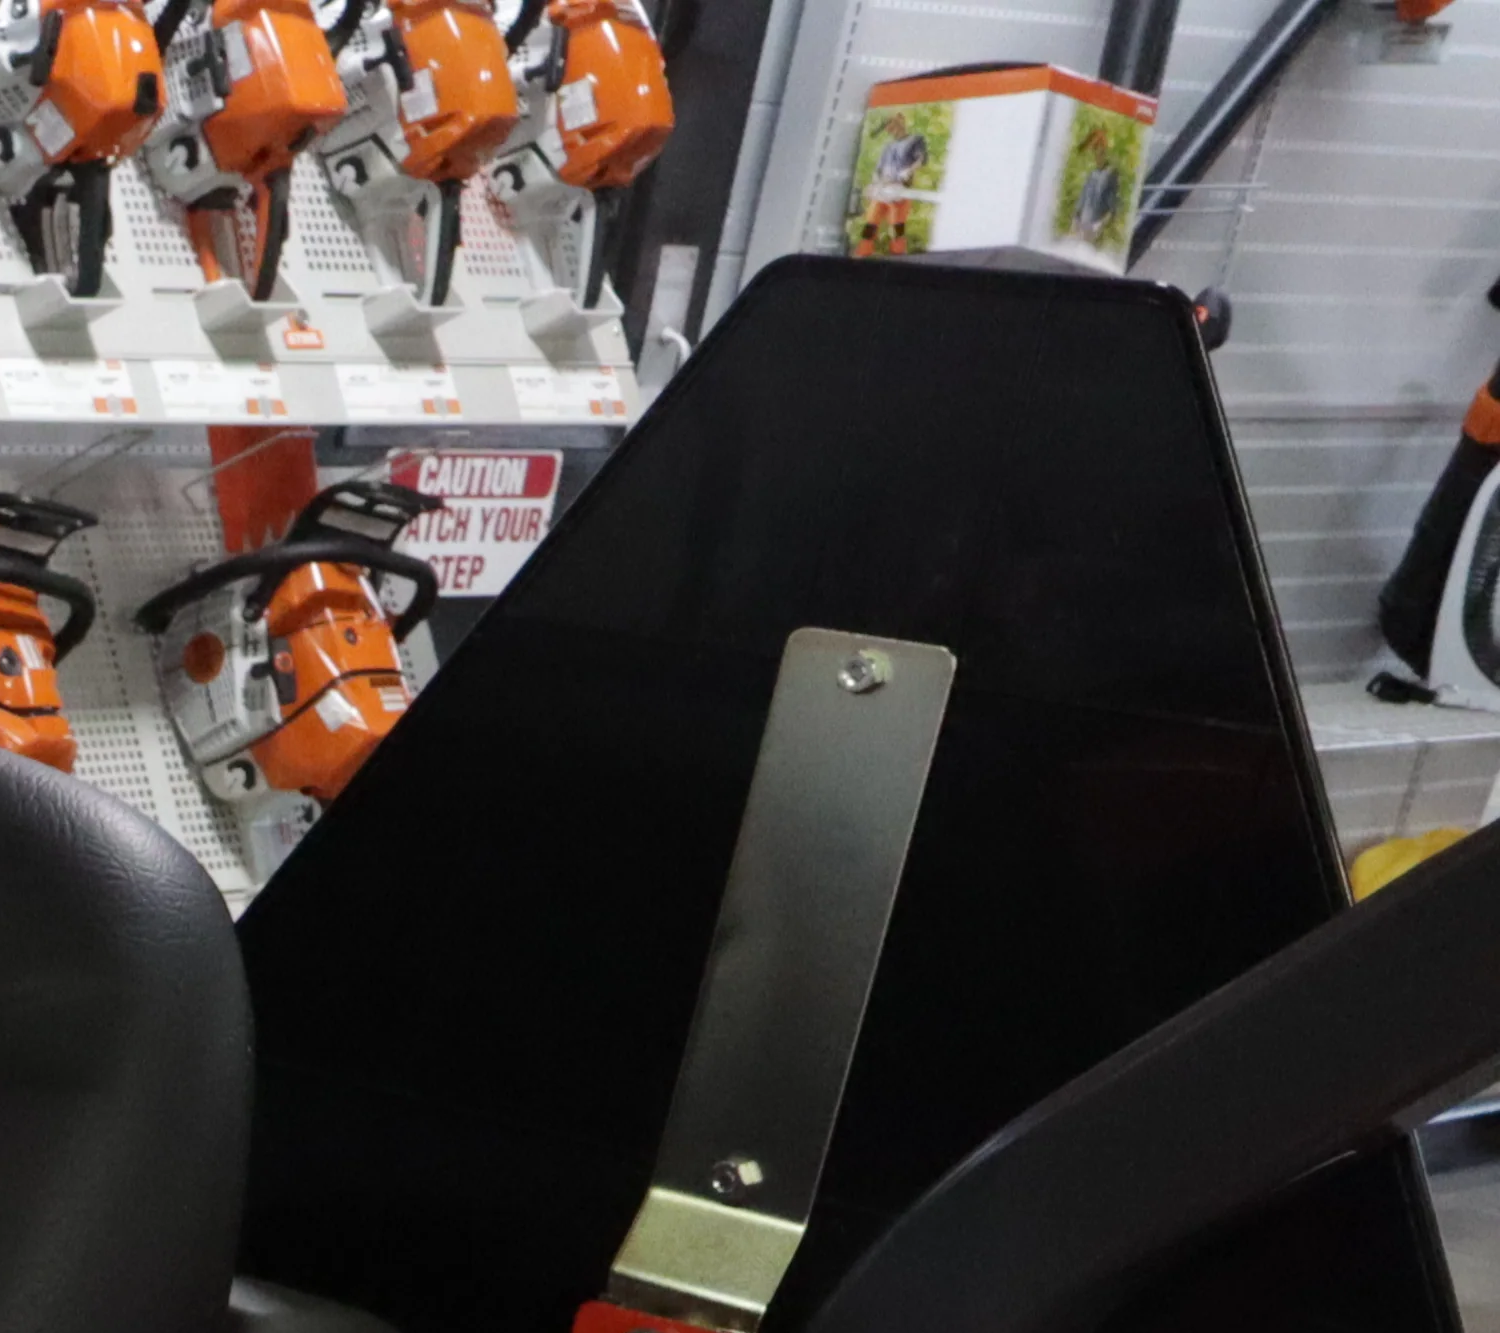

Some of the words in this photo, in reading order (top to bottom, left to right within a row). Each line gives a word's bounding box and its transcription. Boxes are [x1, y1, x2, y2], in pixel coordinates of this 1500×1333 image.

[417, 456, 528, 497] CAUTION
[404, 509, 471, 542] ATCH
[479, 507, 542, 542] YOUR
